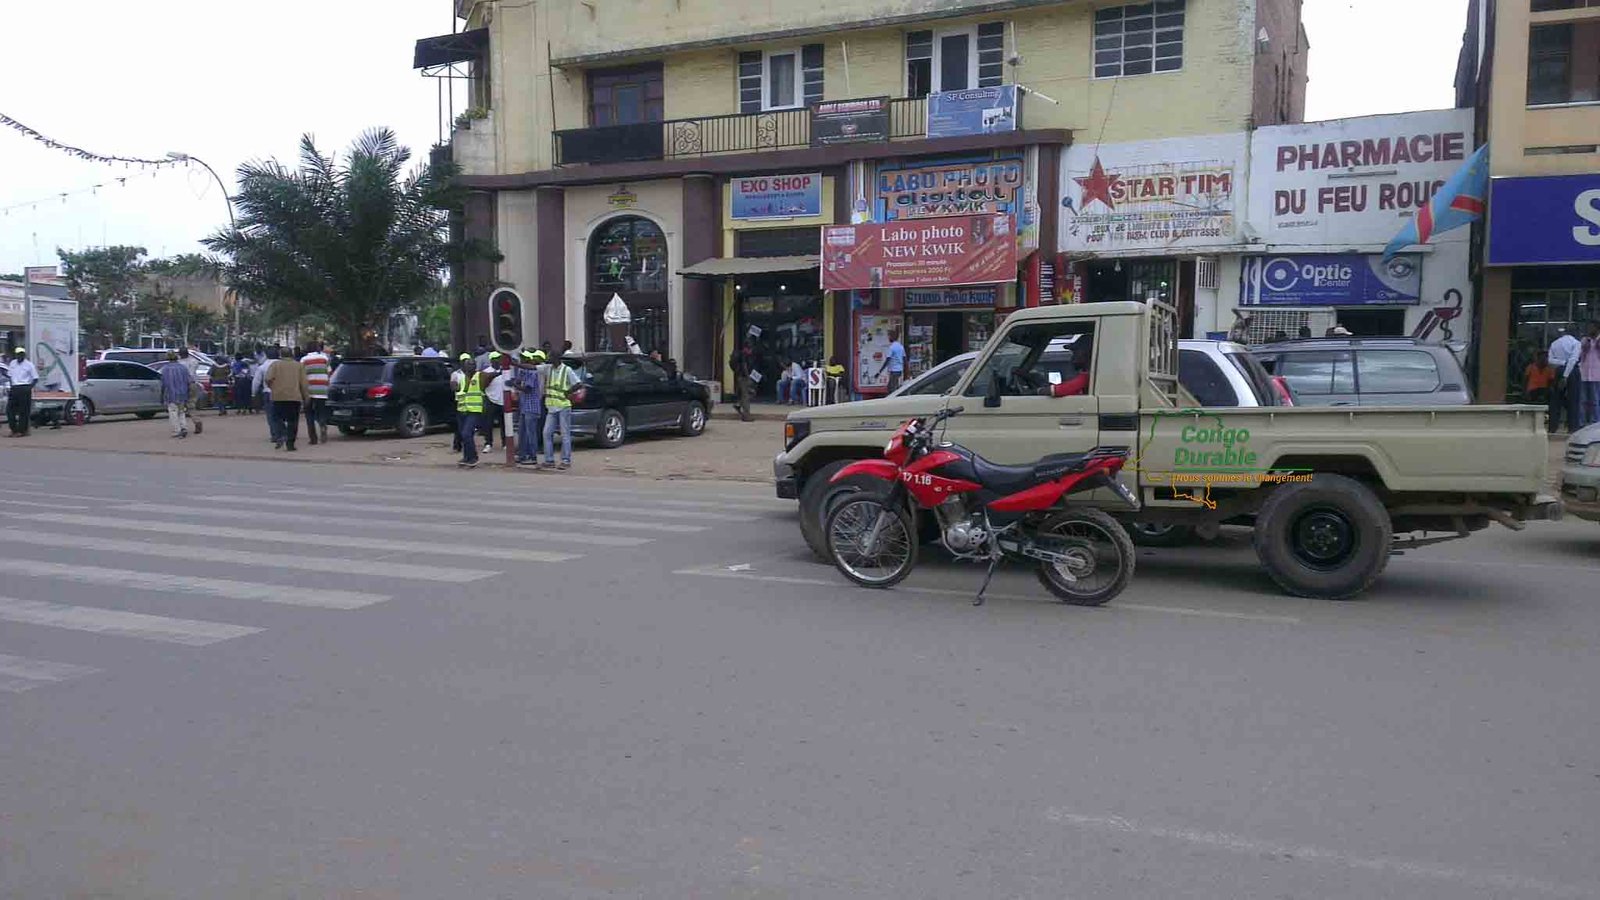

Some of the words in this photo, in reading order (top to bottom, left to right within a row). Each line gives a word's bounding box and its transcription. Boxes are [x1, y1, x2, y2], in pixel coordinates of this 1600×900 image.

[1276, 132, 1464, 172] PHARMACIE
[741, 179, 768, 193] EXO
[773, 176, 811, 191] SHOP
[1111, 176, 1176, 199] STAR
[1180, 171, 1232, 195] TIM
[1275, 189, 1307, 216] DU
[1318, 184, 1367, 214] FEU
[881, 227, 918, 243] Labo
[921, 225, 963, 242] photo
[882, 245, 918, 259] NEW
[922, 242, 965, 256] KWIK
[1319, 279, 1351, 287] Center
